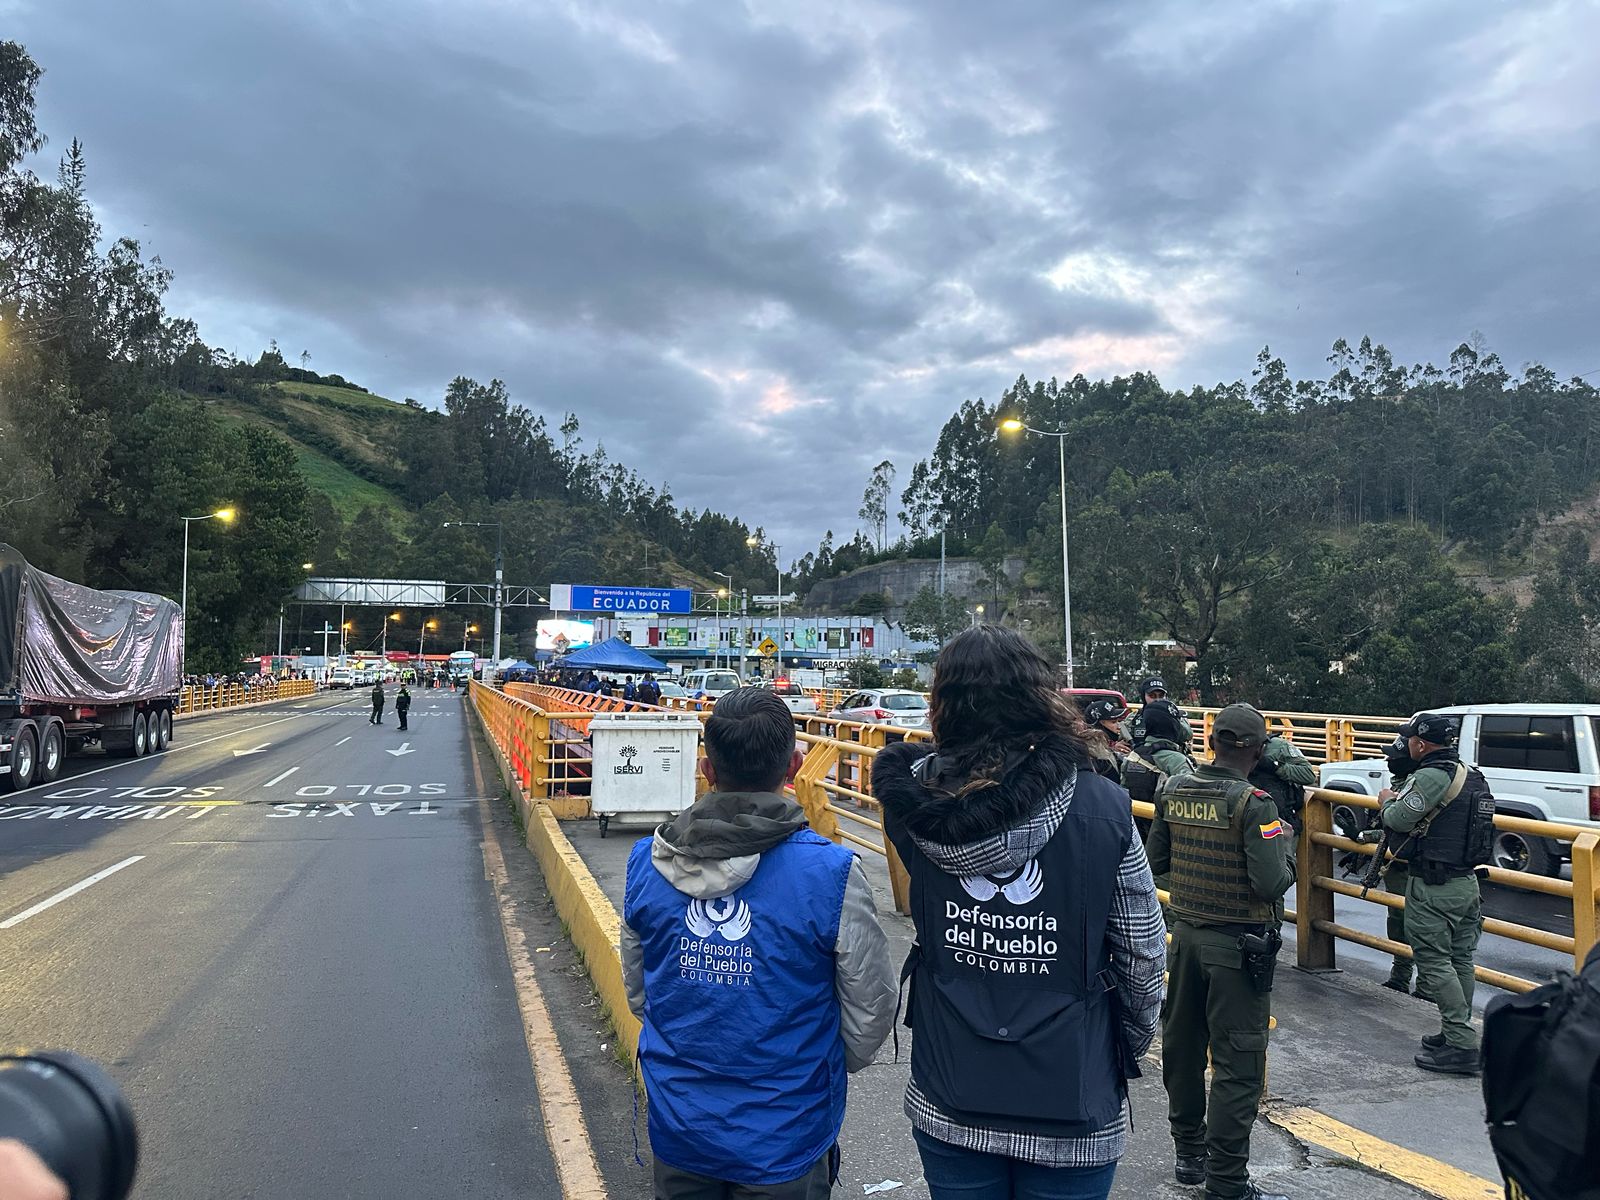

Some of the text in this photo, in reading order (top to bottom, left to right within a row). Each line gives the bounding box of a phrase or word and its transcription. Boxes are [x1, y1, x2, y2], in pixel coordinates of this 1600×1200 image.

[593, 598, 670, 610] ECUADOR
[44, 786, 224, 798] SOLO
[295, 783, 447, 796] SOLO
[0, 805, 219, 820] LIVIANO
[266, 802, 438, 818] TAXIS
[1168, 800, 1218, 822] POLICIA
[946, 900, 1057, 932] Defensoría
[680, 936, 752, 958] Defensoría
[945, 924, 1058, 954] del Pueblo
[680, 952, 752, 972] del Pueblo
[954, 952, 1050, 974] COLOMBIA
[681, 968, 750, 986] COLOMBIA
